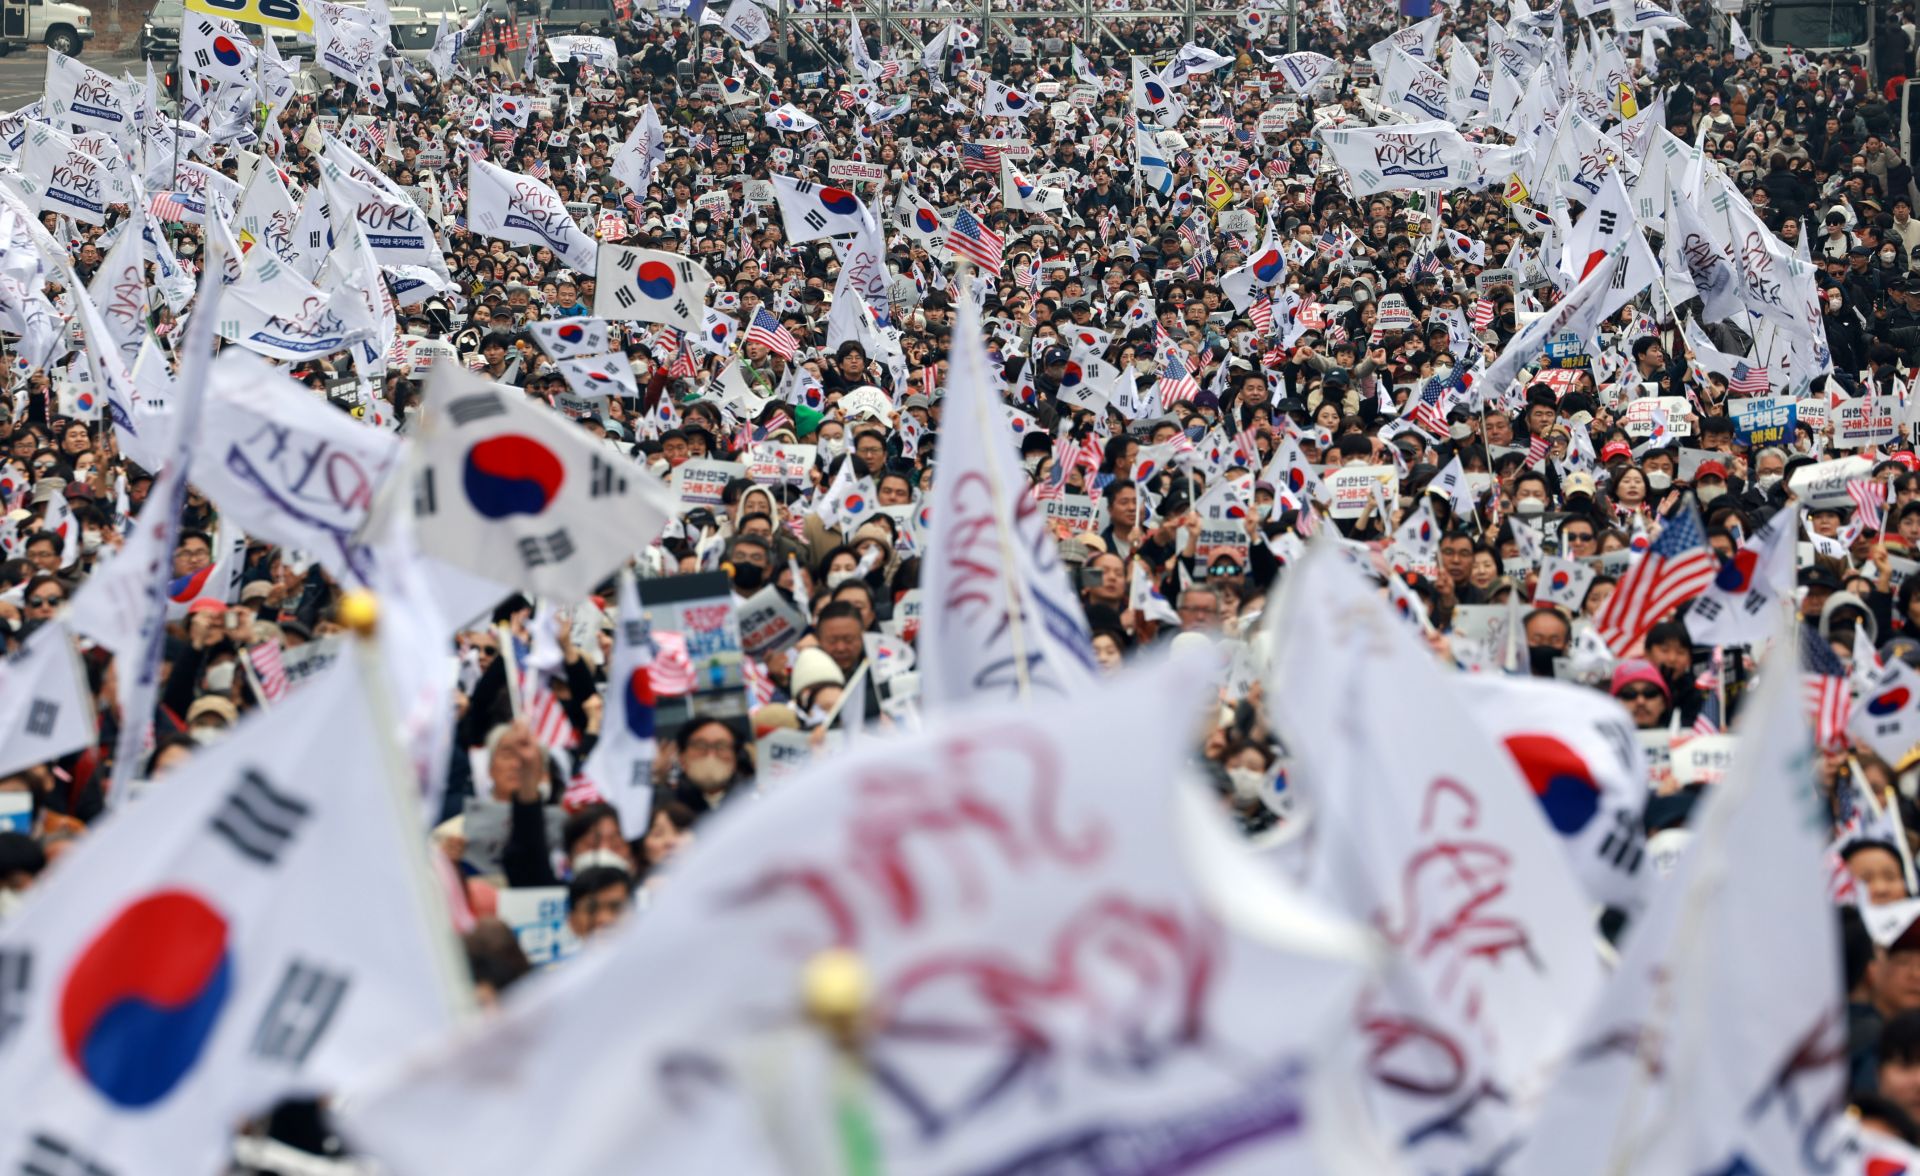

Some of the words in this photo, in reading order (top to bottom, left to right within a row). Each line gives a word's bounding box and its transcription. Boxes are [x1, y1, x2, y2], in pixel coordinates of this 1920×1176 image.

[74, 83, 123, 113] KOREA
[1409, 78, 1450, 110] KOREA
[1374, 138, 1445, 168] KOREA
[66, 152, 98, 177] SAVE
[516, 182, 558, 209] SAVE
[1481, 274, 1513, 283] 대한민국을
[1561, 354, 1591, 369] 해체!
[1747, 398, 1776, 412] 더불어
[1631, 422, 1687, 433] 싸우니다
[1738, 407, 1790, 432] 탄핵당
[1750, 425, 1785, 445] 해체!
[1336, 487, 1390, 501] 구해주요
[1200, 529, 1247, 543] 한민국을
